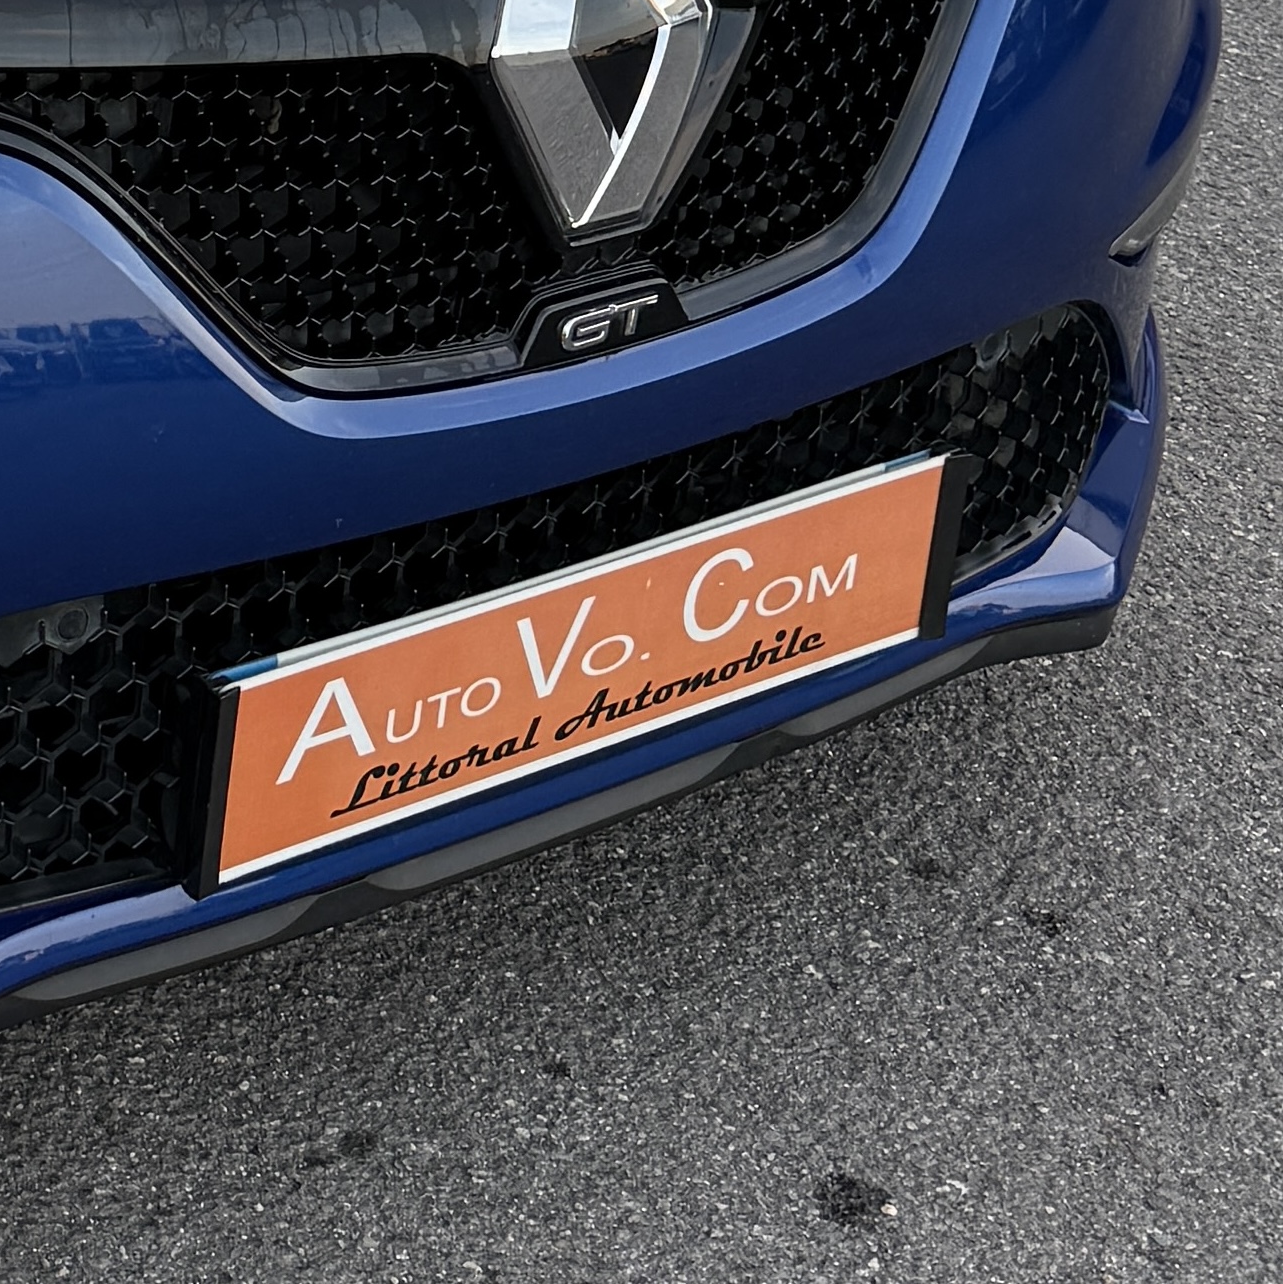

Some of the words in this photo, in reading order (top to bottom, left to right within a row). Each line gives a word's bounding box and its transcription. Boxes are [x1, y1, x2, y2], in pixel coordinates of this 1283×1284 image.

[561, 294, 659, 351] GT
[330, 716, 542, 819] Littoral
[553, 625, 827, 743] Automobile
